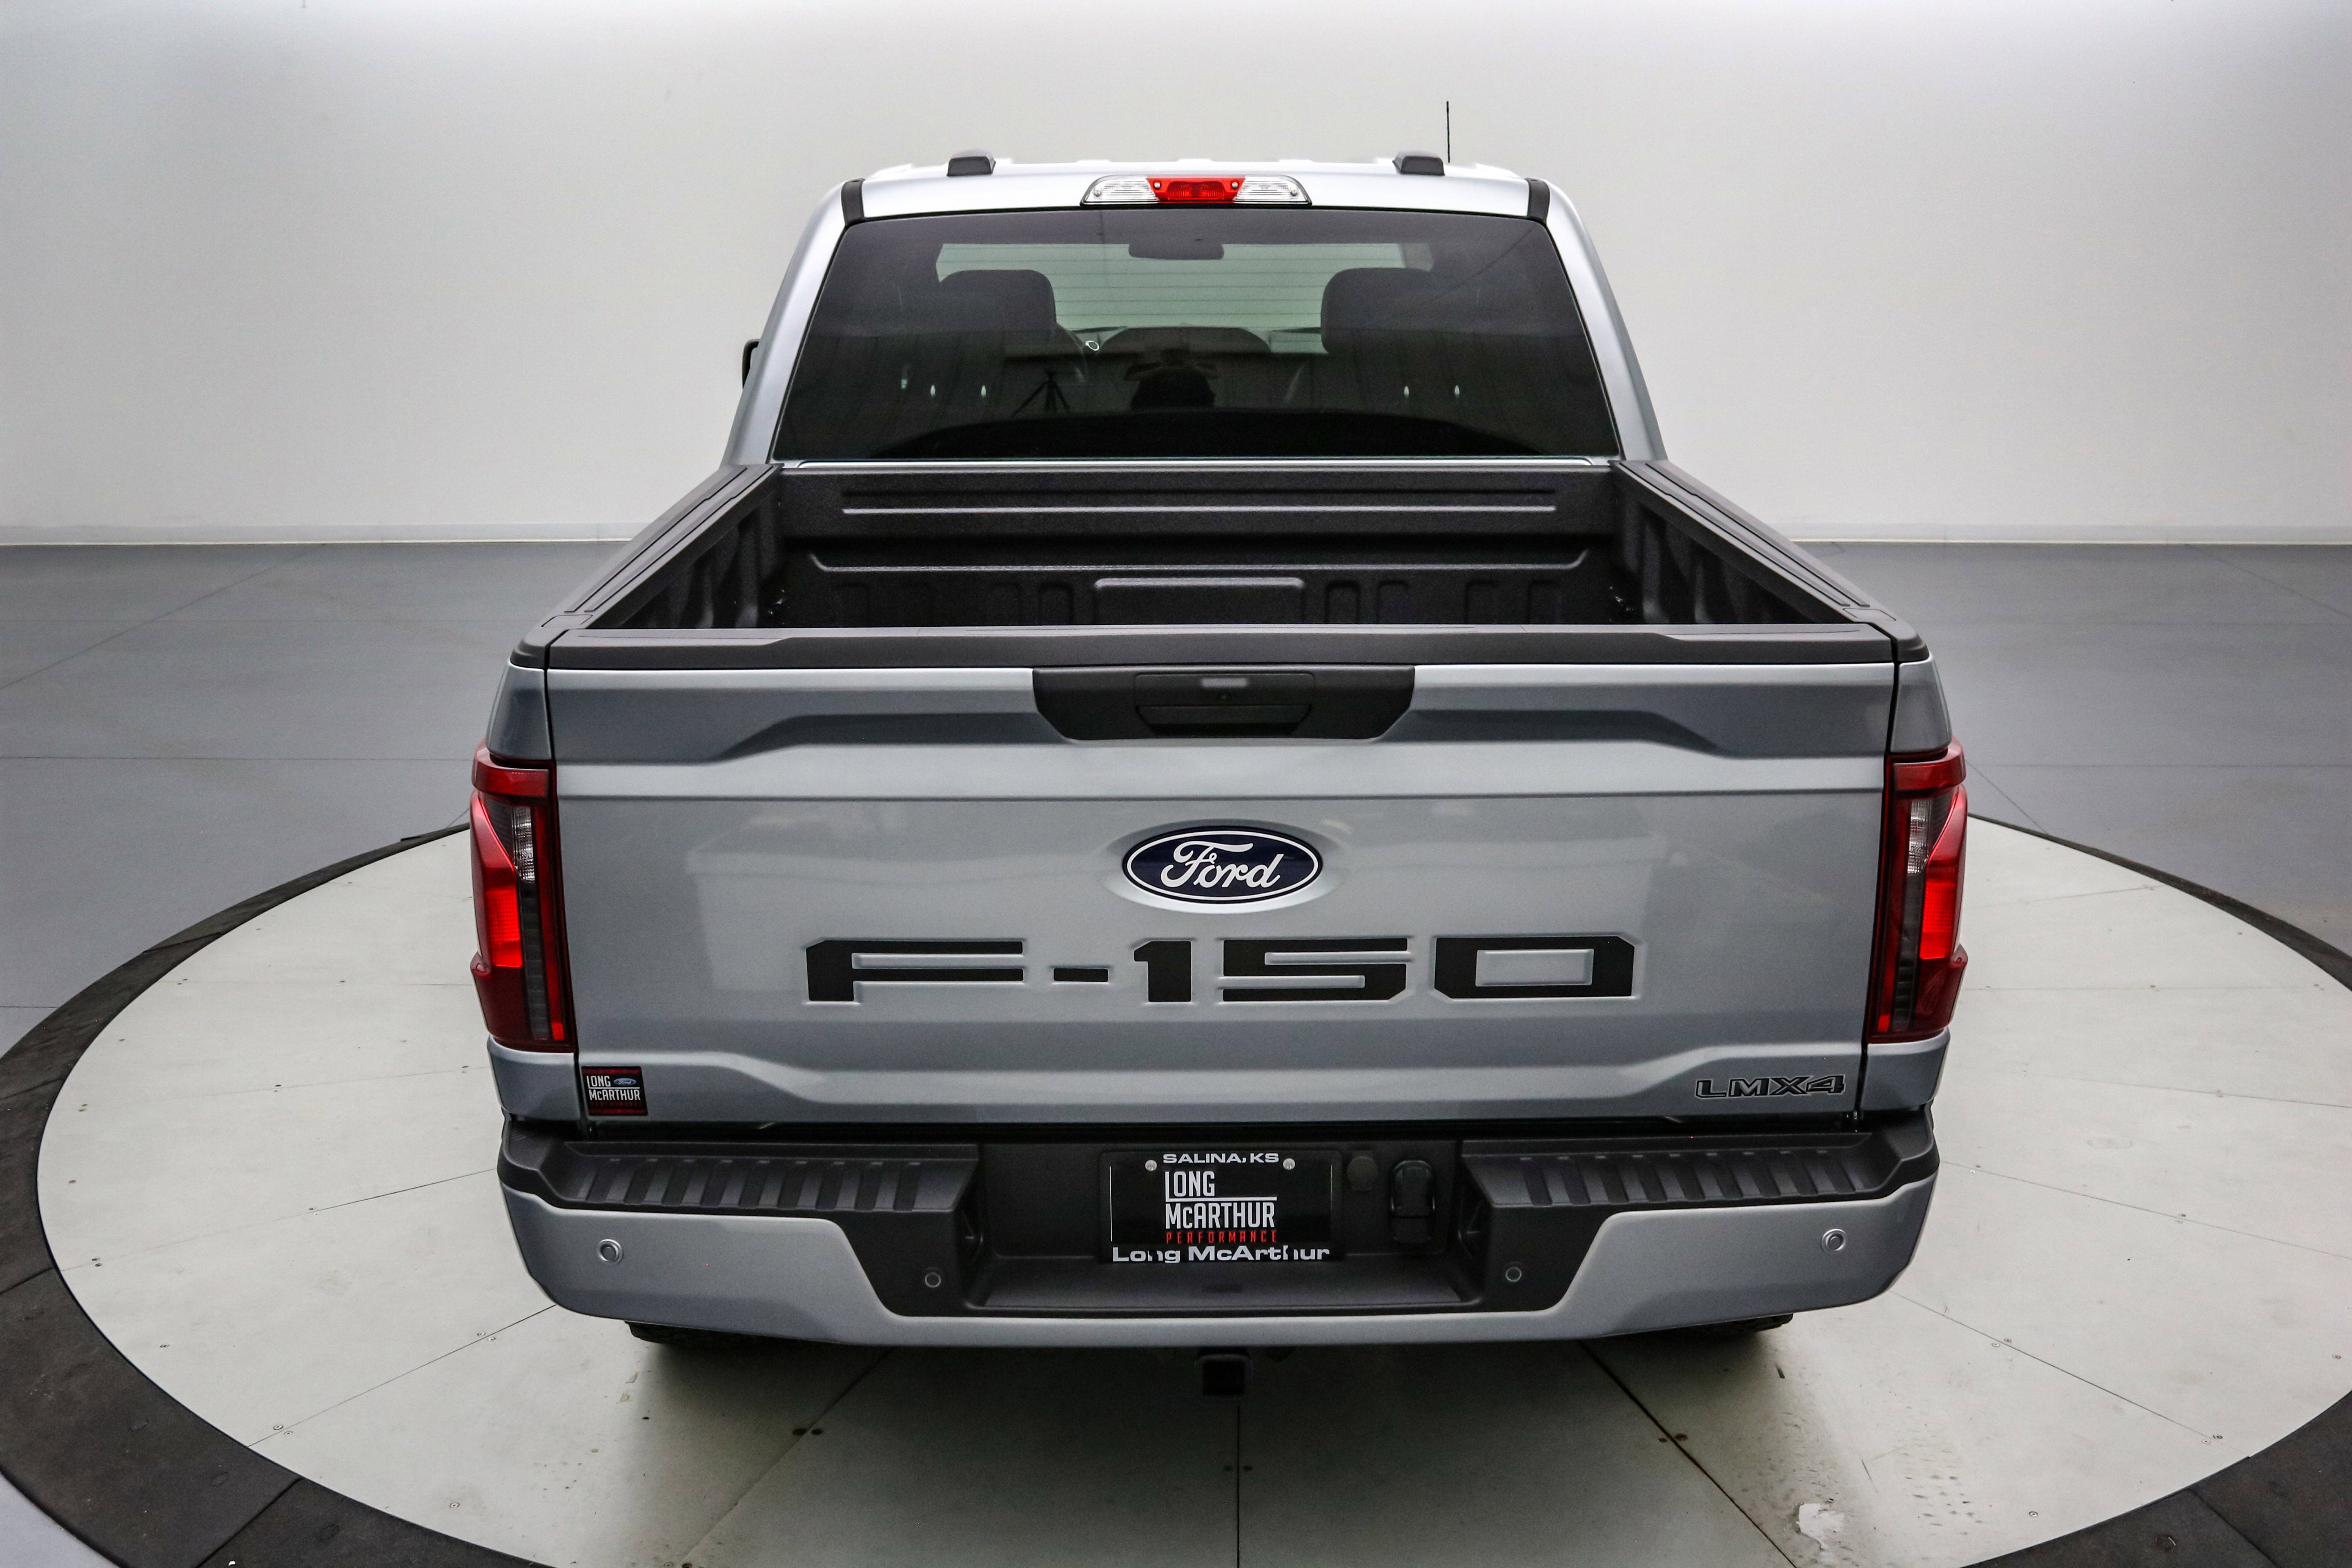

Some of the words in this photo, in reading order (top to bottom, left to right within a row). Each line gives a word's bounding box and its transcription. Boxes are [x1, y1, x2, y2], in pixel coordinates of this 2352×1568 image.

[1160, 840, 1284, 888] Ford
[805, 936, 1636, 1003] F-150
[586, 1076, 611, 1089] LONG
[1695, 1075, 1846, 1099] LMX4
[588, 1089, 641, 1100] McARTHUR
[1163, 1153, 1247, 1164] SALINA,
[1250, 1153, 1279, 1163] KS
[1165, 1171, 1215, 1201] LONG
[1165, 1202, 1275, 1229] McARTHUR
[1166, 1230, 1277, 1244] PERFORMANCE
[1112, 1247, 1181, 1263] Long
[1188, 1245, 1330, 1261] McArthur
